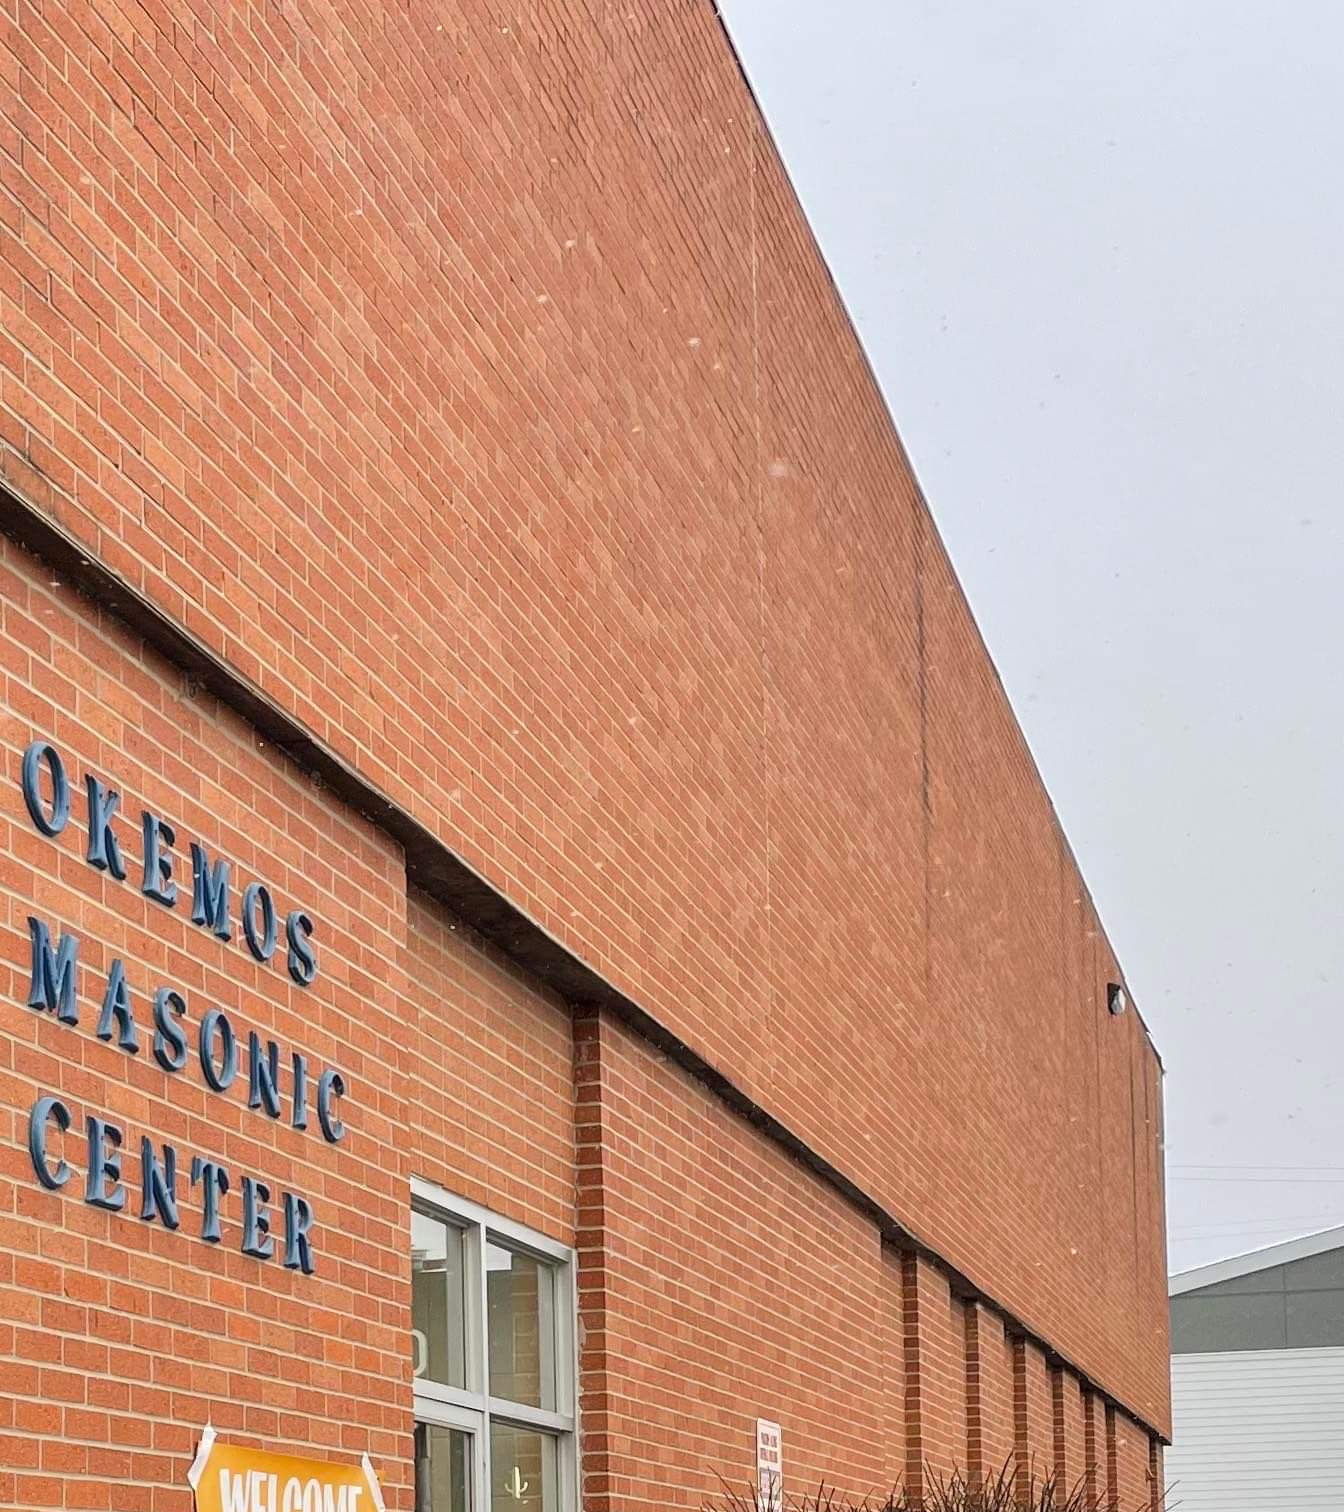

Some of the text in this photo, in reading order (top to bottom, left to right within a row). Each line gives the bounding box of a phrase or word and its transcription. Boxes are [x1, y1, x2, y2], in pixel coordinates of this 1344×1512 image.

[21, 740, 318, 986] OKEMOS
[26, 916, 346, 1144] MASONIC
[29, 1096, 315, 1275] CENTER
